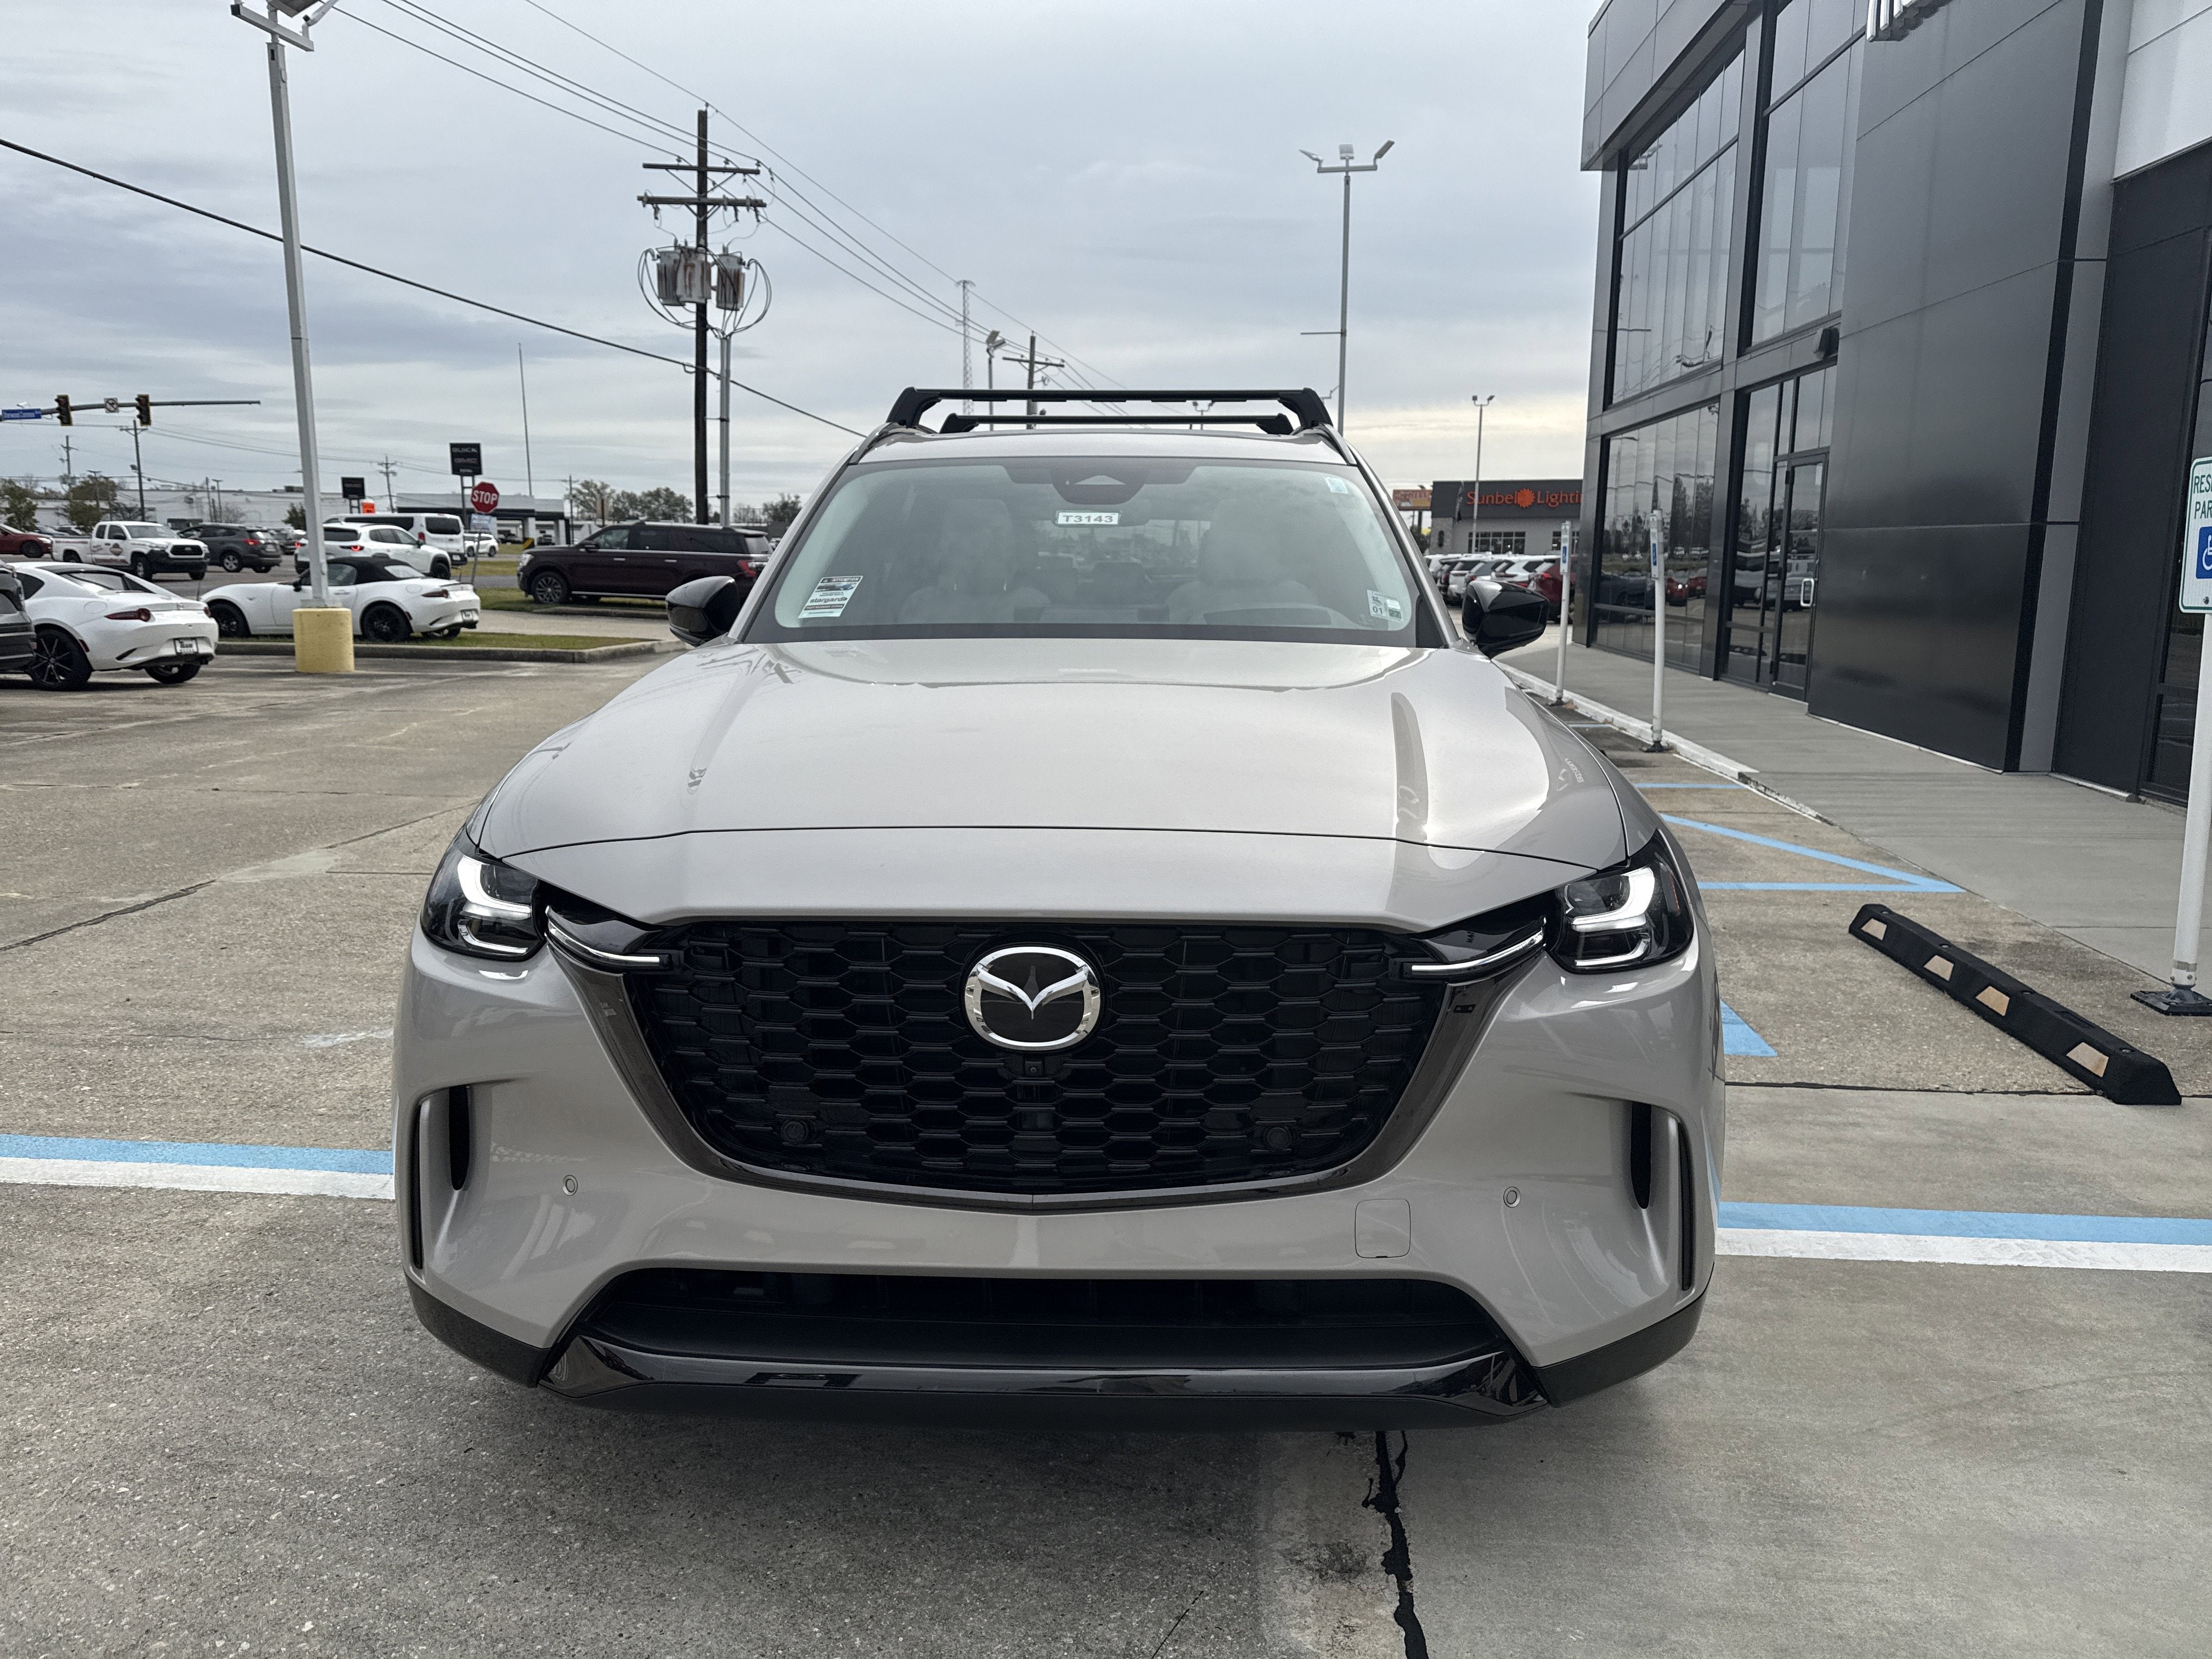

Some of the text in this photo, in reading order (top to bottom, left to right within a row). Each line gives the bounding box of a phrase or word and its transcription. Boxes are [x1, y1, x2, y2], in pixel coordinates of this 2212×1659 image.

[2193, 474, 2212, 494] RES
[472, 490, 498, 505] STOP
[1538, 490, 1582, 507] Lighti
[1373, 606, 1383, 614] 01
